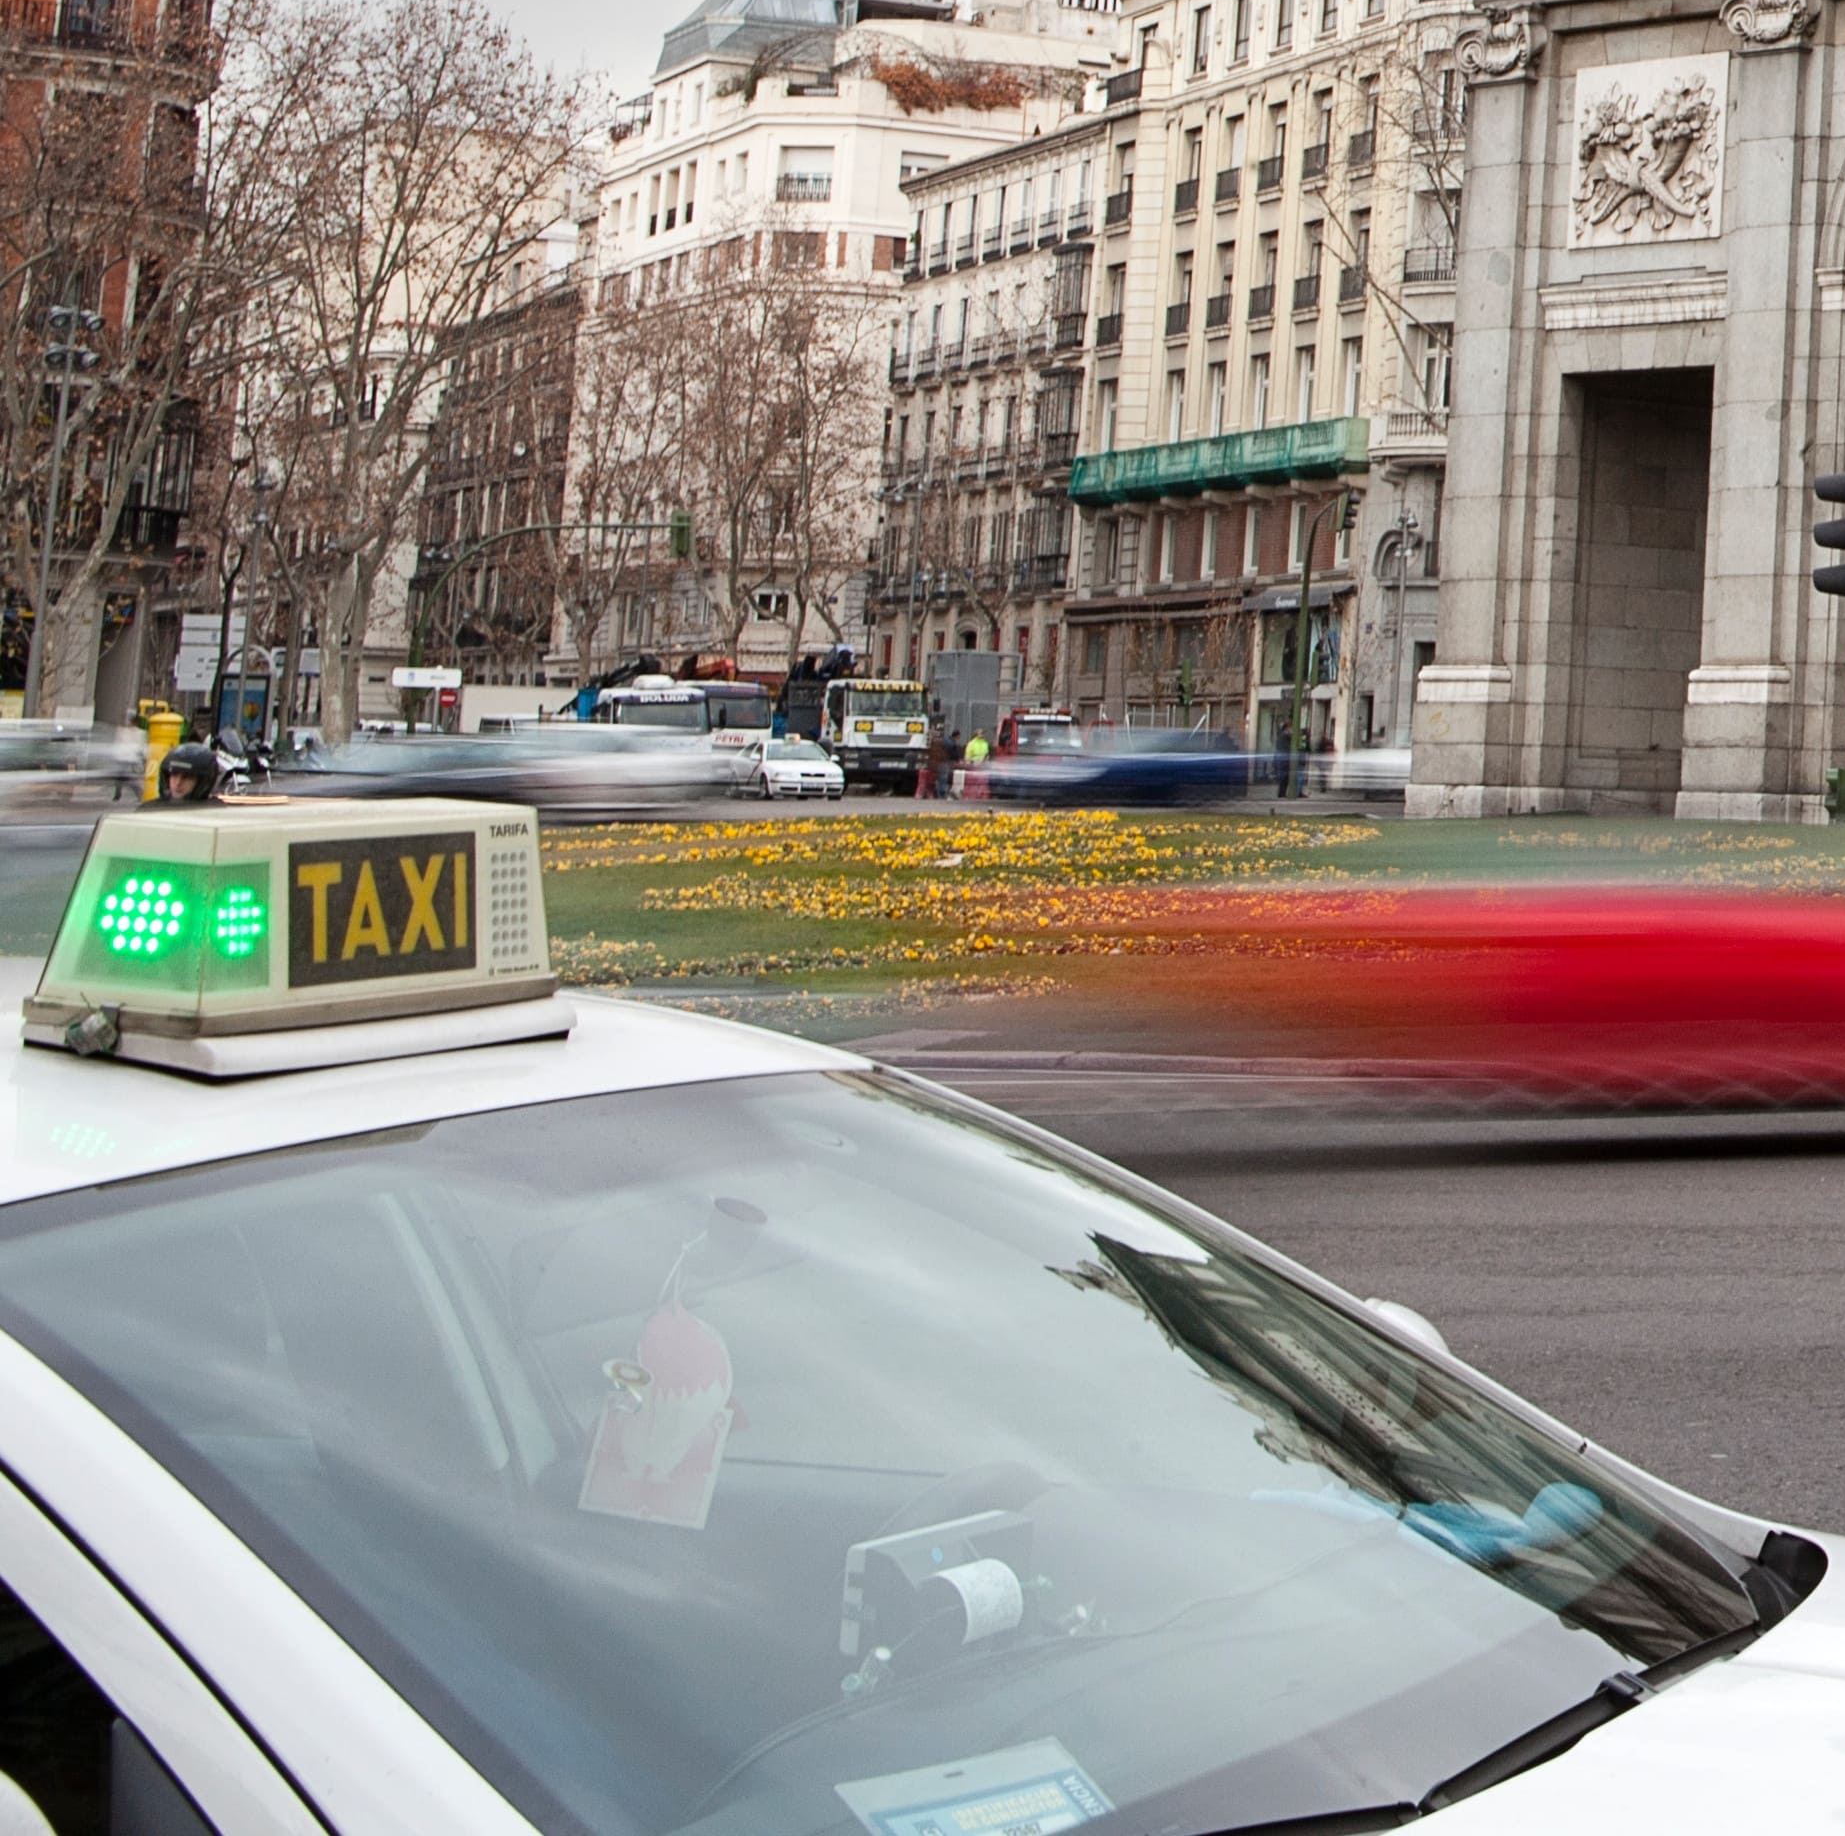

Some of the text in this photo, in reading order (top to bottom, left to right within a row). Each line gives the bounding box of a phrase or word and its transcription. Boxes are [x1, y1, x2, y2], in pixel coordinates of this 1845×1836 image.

[489, 823, 529, 838] TARIFA
[297, 852, 468, 964] TAXI
[1062, 1774, 1104, 1816] ENCIA
